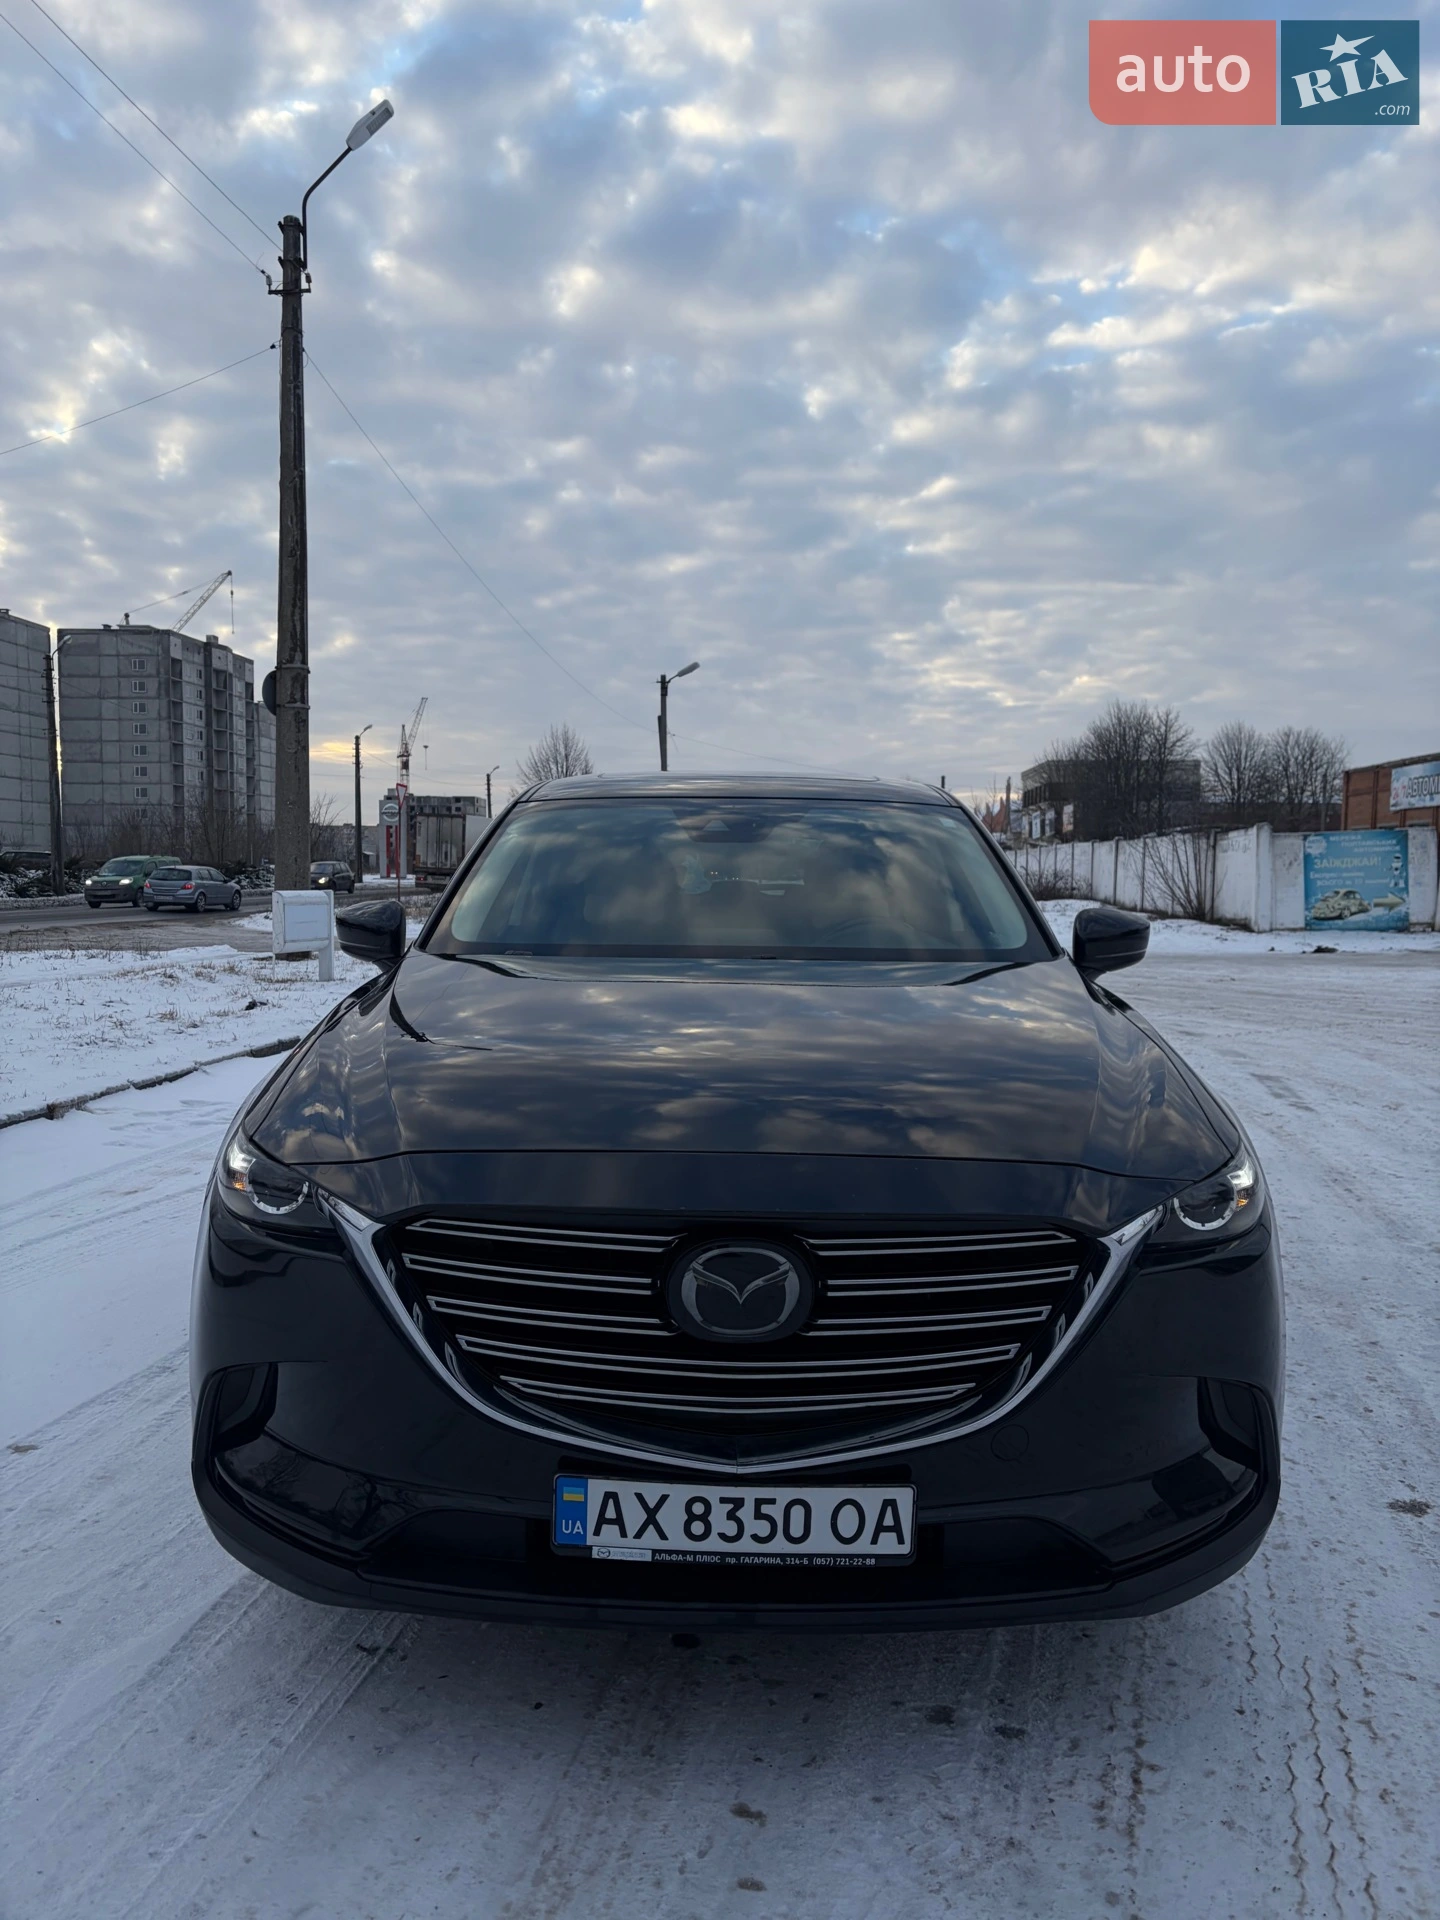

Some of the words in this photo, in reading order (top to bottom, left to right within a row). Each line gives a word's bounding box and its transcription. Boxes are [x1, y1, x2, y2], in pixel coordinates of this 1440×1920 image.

[1314, 855, 1382, 868] ЗАЇЖДЖАЙ!
[592, 1490, 671, 1542] AX
[683, 1495, 813, 1545] 8350
[829, 1498, 906, 1546] OA
[561, 1519, 584, 1536] UA
[654, 1552, 694, 1563] АЛЬФА-М
[695, 1554, 722, 1564] ПЛЮС
[726, 1556, 739, 1566] пр.
[740, 1555, 784, 1566] ГАГАРИНА,
[813, 1557, 834, 1567] (057)
